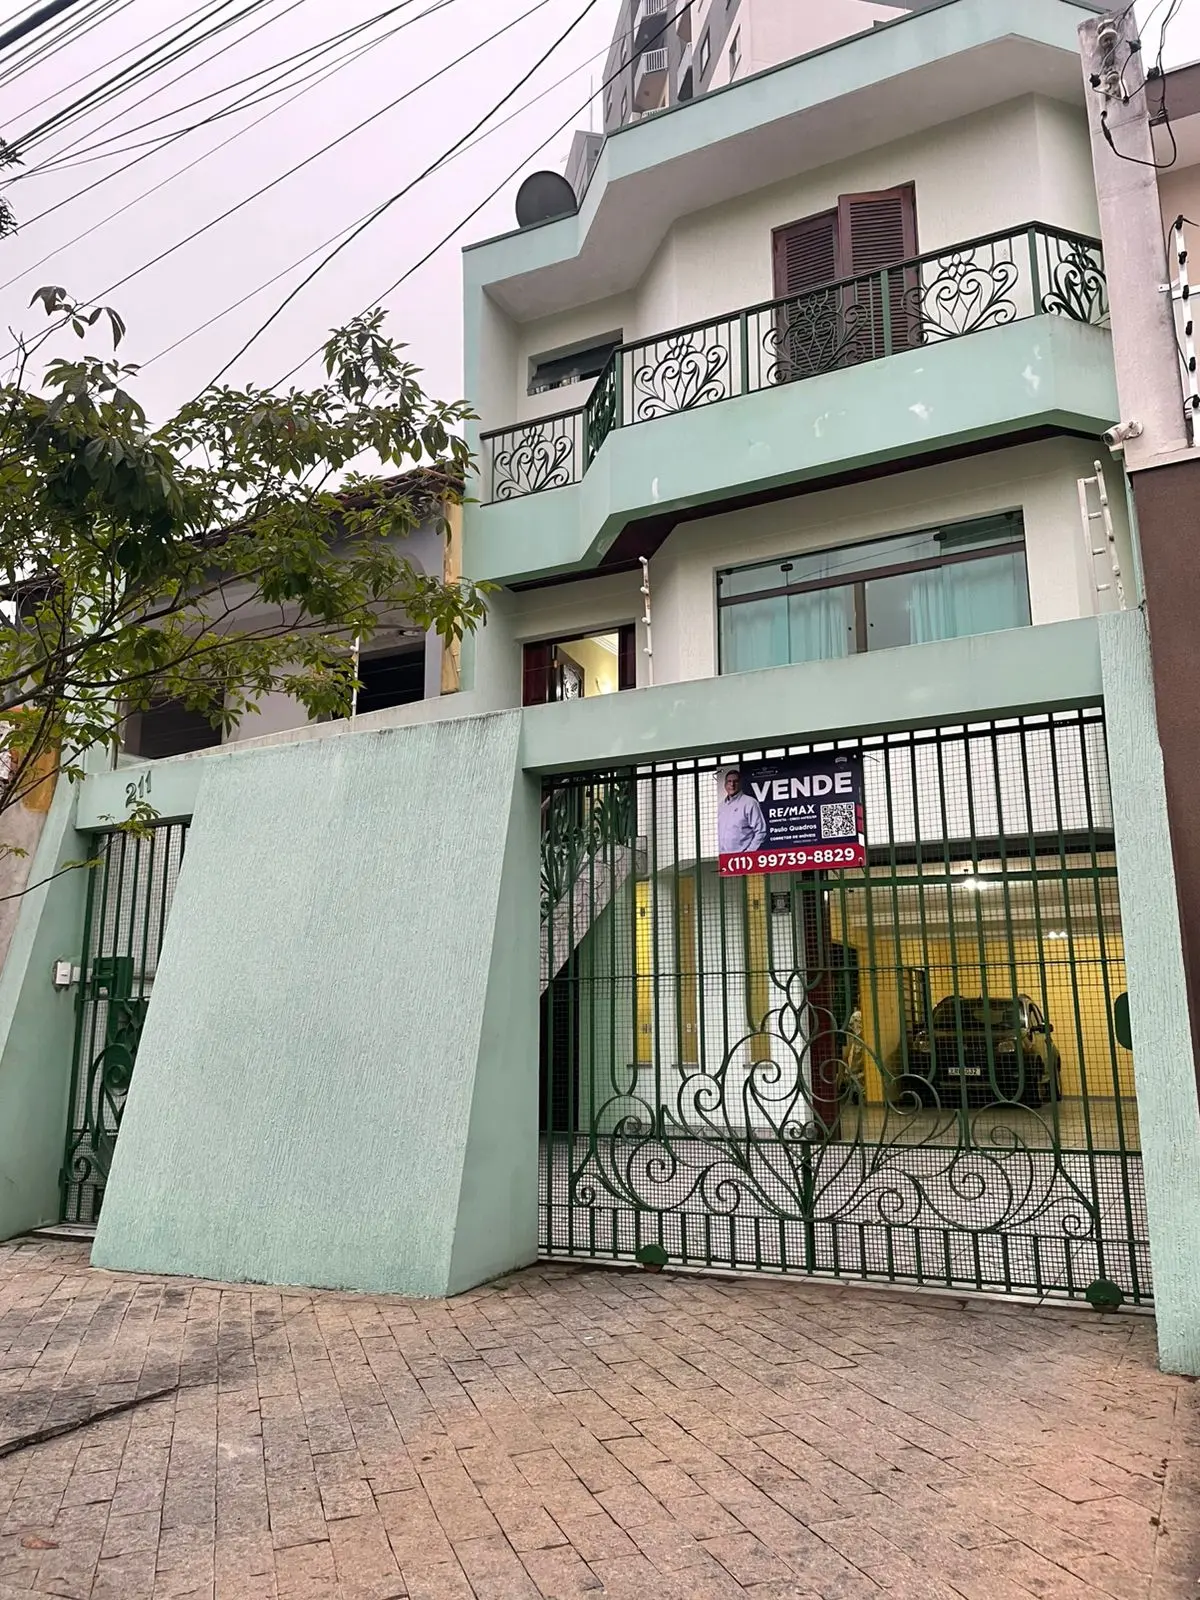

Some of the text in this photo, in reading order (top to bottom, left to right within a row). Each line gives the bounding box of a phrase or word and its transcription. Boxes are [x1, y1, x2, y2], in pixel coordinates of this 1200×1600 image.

[125, 770, 152, 807] 211
[751, 771, 853, 802] VENDE
[769, 804, 815, 818] RE/MAX
[789, 824, 817, 832] Quadros
[727, 847, 855, 871] (11) 99739-8829
